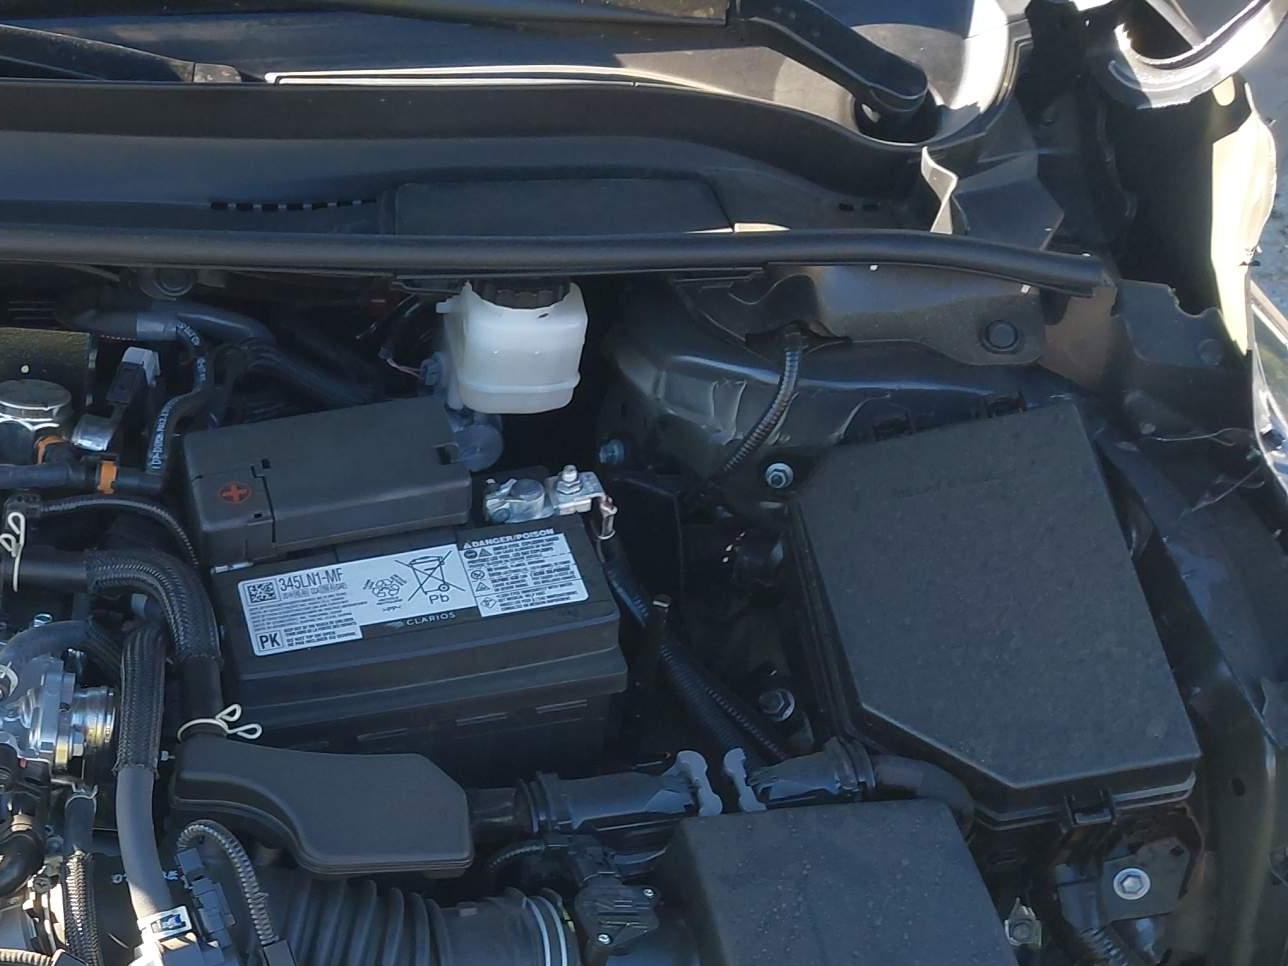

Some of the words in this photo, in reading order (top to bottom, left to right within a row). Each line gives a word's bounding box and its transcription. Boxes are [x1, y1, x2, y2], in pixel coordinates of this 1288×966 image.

[472, 528, 555, 548] DANGER/POISON
[279, 568, 345, 592] 345LN1-MF
[428, 593, 451, 604] Pb
[406, 612, 456, 626] CLARIOS
[260, 634, 281, 650] PK
